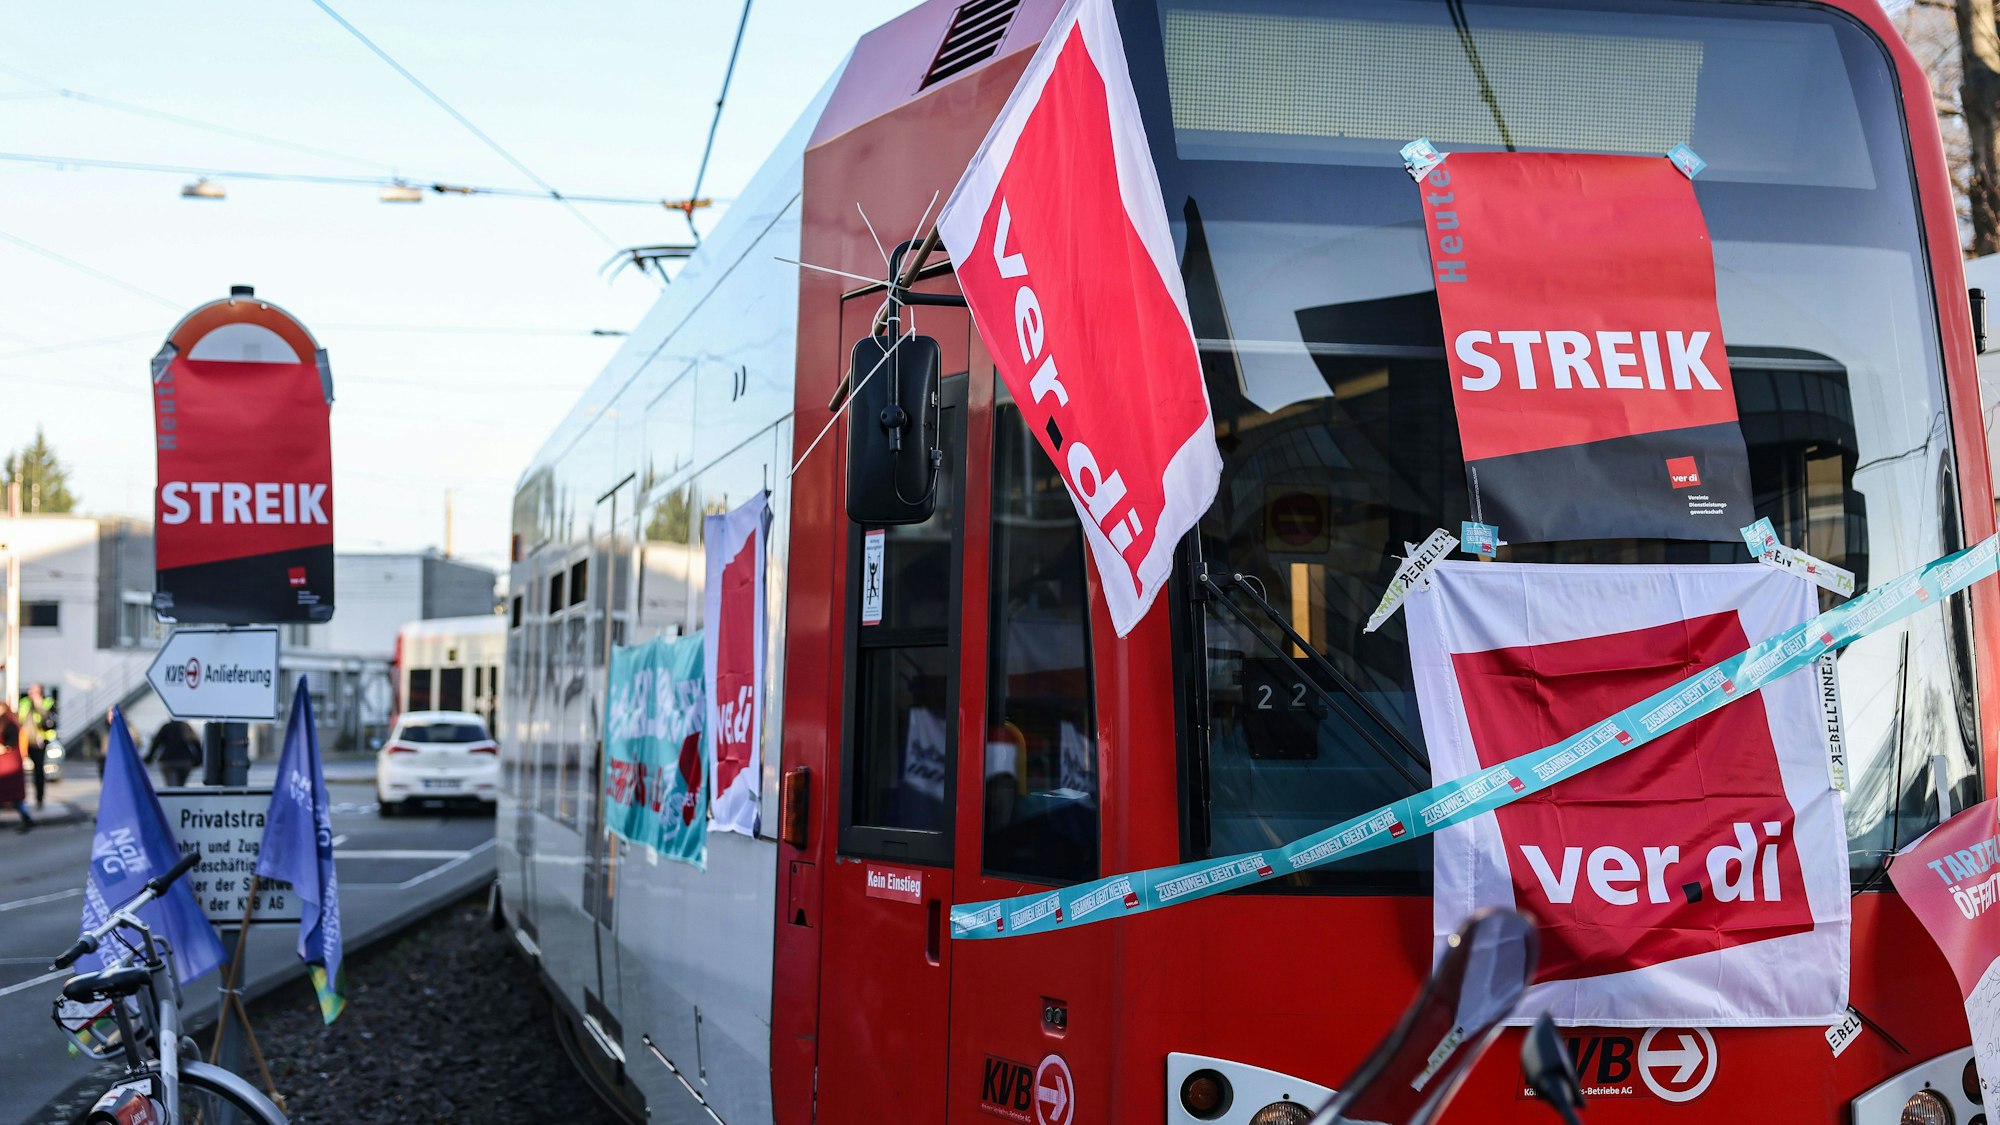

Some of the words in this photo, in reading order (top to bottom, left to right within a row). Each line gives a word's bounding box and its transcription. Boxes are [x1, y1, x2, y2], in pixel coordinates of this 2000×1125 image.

[1426, 169, 1467, 283] Heute
[994, 196, 1143, 556] ver.di
[1455, 330, 1723, 391] STREIK
[157, 369, 177, 450] Heute
[161, 481, 329, 525] STREIK
[1784, 636, 1805, 655] GEHT
[204, 664, 271, 688] Anlieferung
[717, 685, 753, 745] vedi
[1643, 699, 1681, 731] ZUSAMMEN
[1682, 685, 1705, 706] GEHT
[1705, 670, 1727, 690] MEHR
[1536, 748, 1574, 780] ZUSAMMEN
[1575, 737, 1594, 758] GEHT
[1596, 723, 1621, 744] MEHR
[1424, 792, 1468, 824] ZUSAMMEN
[1469, 781, 1489, 801] GEHT
[1490, 768, 1513, 788] MEHR
[181, 809, 265, 828] Privatstra
[1291, 838, 1342, 868] ZUSAMMEN
[1343, 826, 1368, 846] GEHT
[1371, 812, 1398, 833] MEHR
[177, 839, 201, 852] ahrt
[208, 839, 231, 853] und
[238, 839, 259, 855] Zug
[192, 857, 257, 874] Beschäftig
[1519, 821, 1782, 905] ver.di
[215, 879, 235, 892] der
[868, 870, 886, 889] Kein
[887, 873, 921, 898] Einstieg
[1070, 896, 1096, 917] ZUSAMMEN
[1096, 889, 1109, 907] GEHT
[1109, 880, 1132, 899] MEHR
[1158, 873, 1208, 899] ZUSAMMEN
[1210, 865, 1235, 885] GEHT
[1239, 857, 1267, 875] MEHR
[209, 898, 230, 911] der
[268, 898, 285, 910] AG
[982, 1058, 1033, 1111] KVB
[1580, 1086, 1620, 1096] s-Betriebe
[1621, 1087, 1633, 1095] AG
